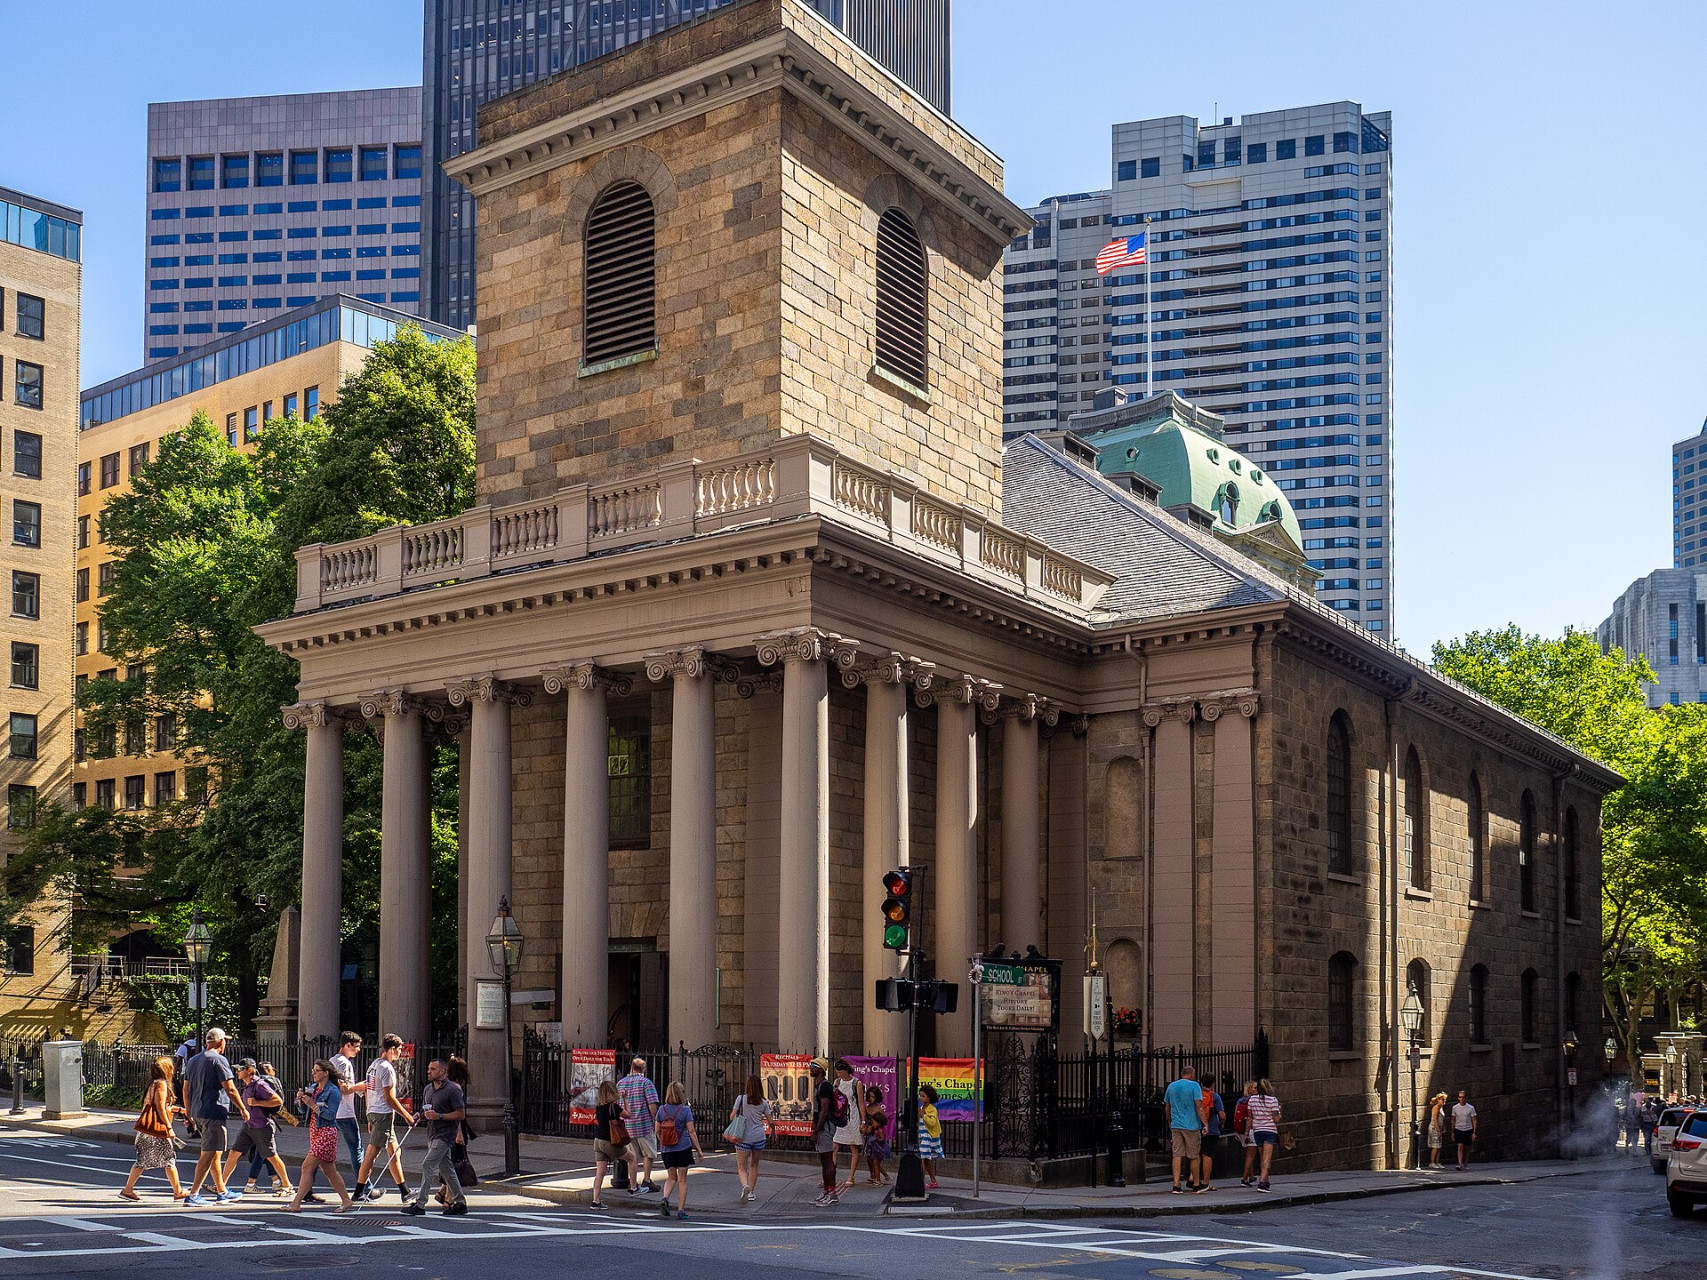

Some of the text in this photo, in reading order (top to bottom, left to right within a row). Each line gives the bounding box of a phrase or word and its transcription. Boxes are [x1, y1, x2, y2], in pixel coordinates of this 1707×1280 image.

[988, 968, 1014, 983] SCHOOL
[854, 1065, 896, 1075] ing's Chapel
[944, 1078, 983, 1091] Chapl
[790, 1124, 812, 1132] CHAPEL
